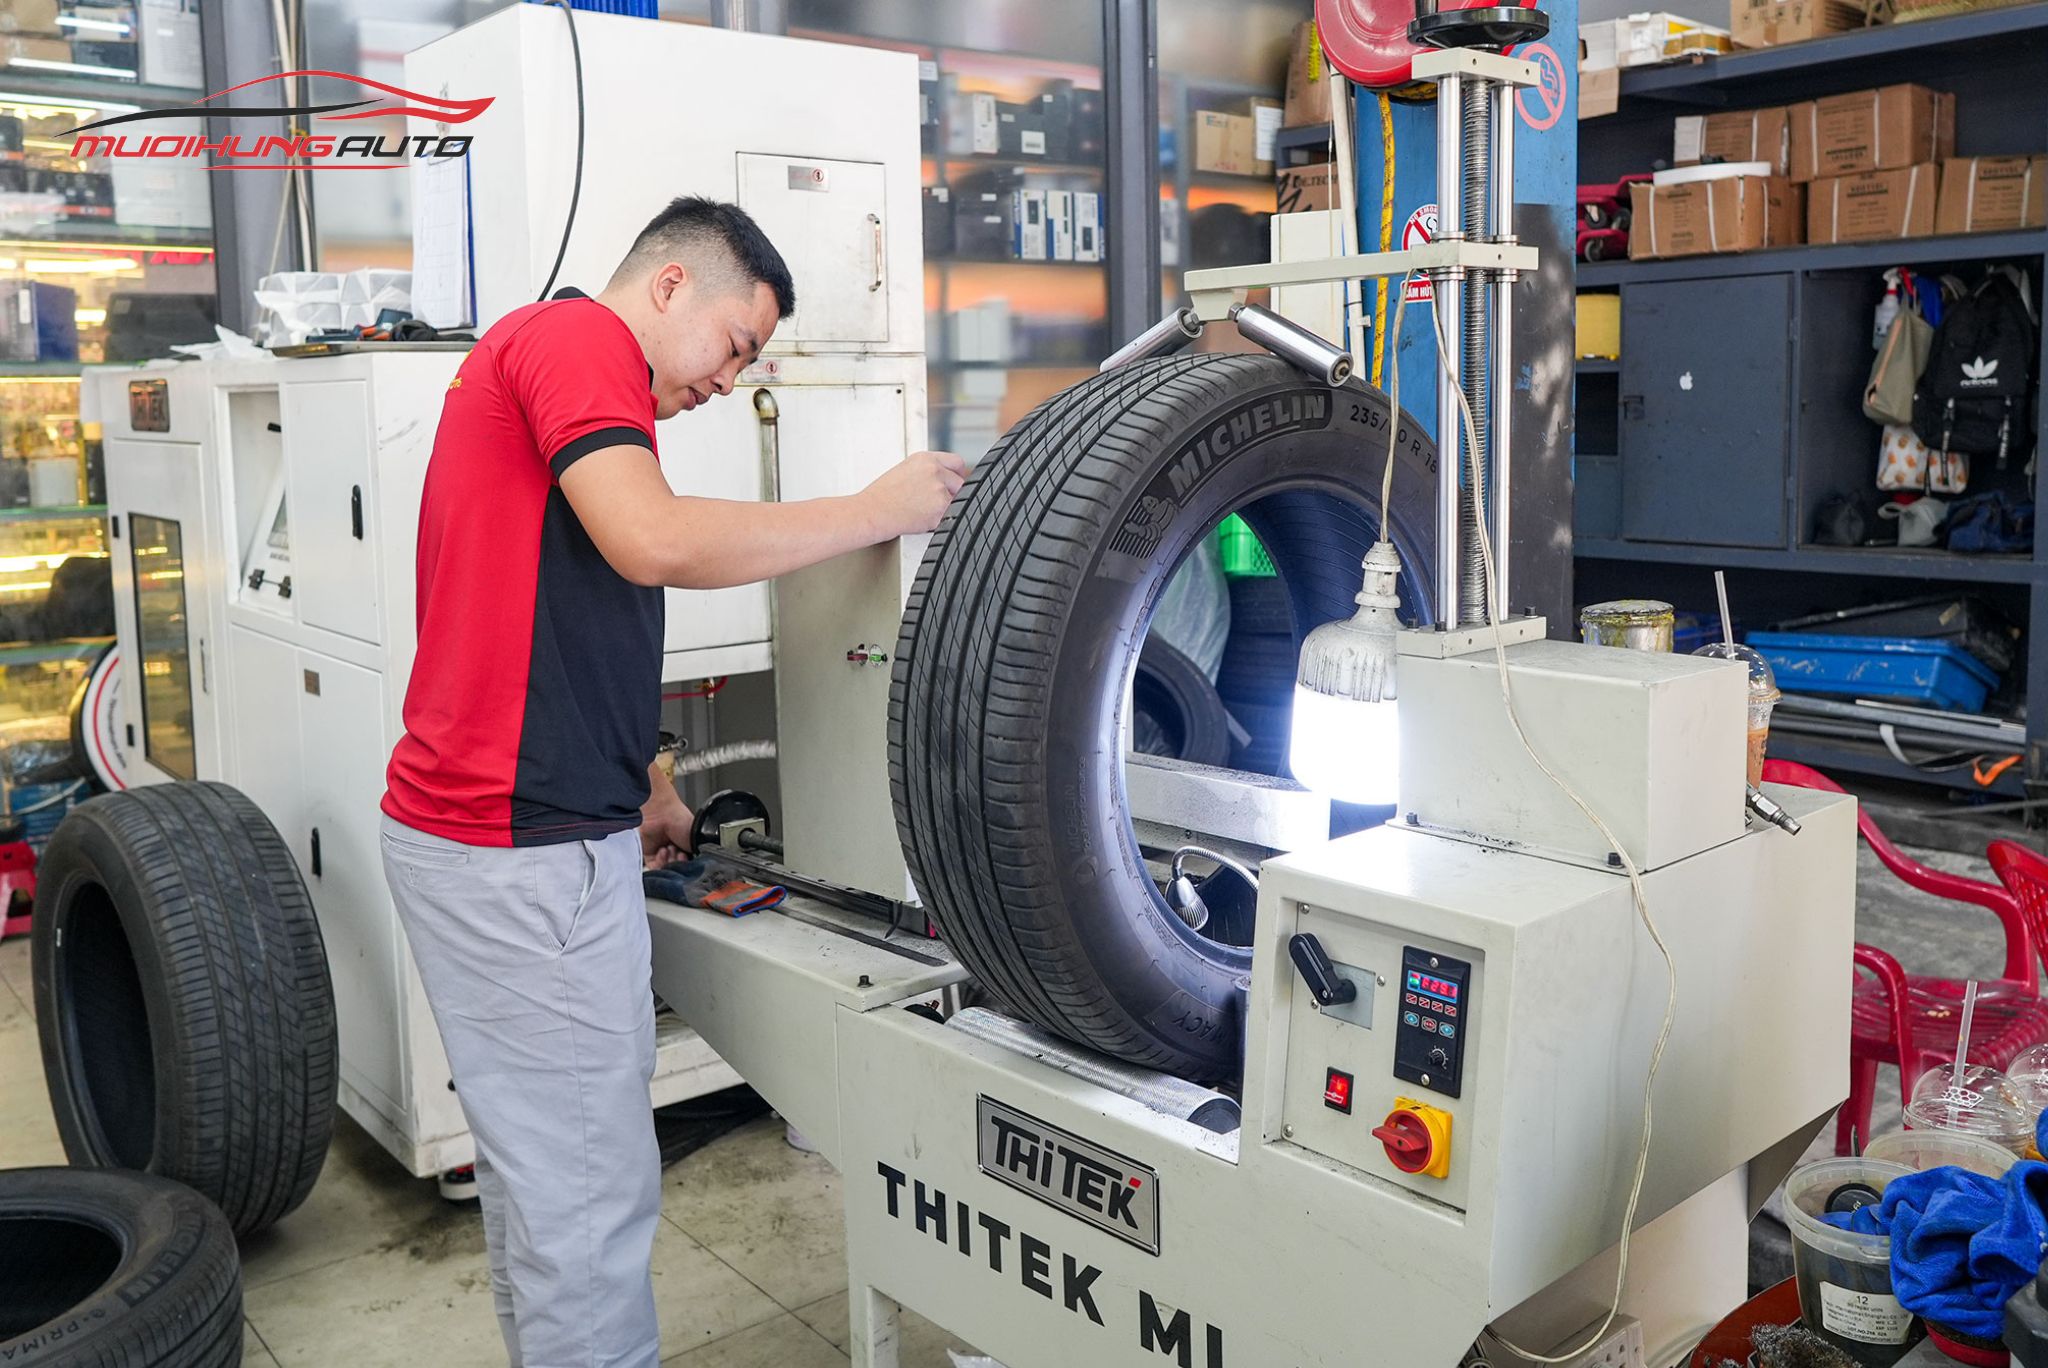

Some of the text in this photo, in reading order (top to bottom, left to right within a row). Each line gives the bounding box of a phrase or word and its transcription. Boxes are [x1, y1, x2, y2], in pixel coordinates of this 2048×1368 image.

[1167, 394, 1326, 498] MICHELIN
[1350, 404, 1407, 443] 235/0
[1410, 439, 1421, 456] R
[877, 1160, 1105, 1327] THITEK
[1856, 1296, 1869, 1305] 12
